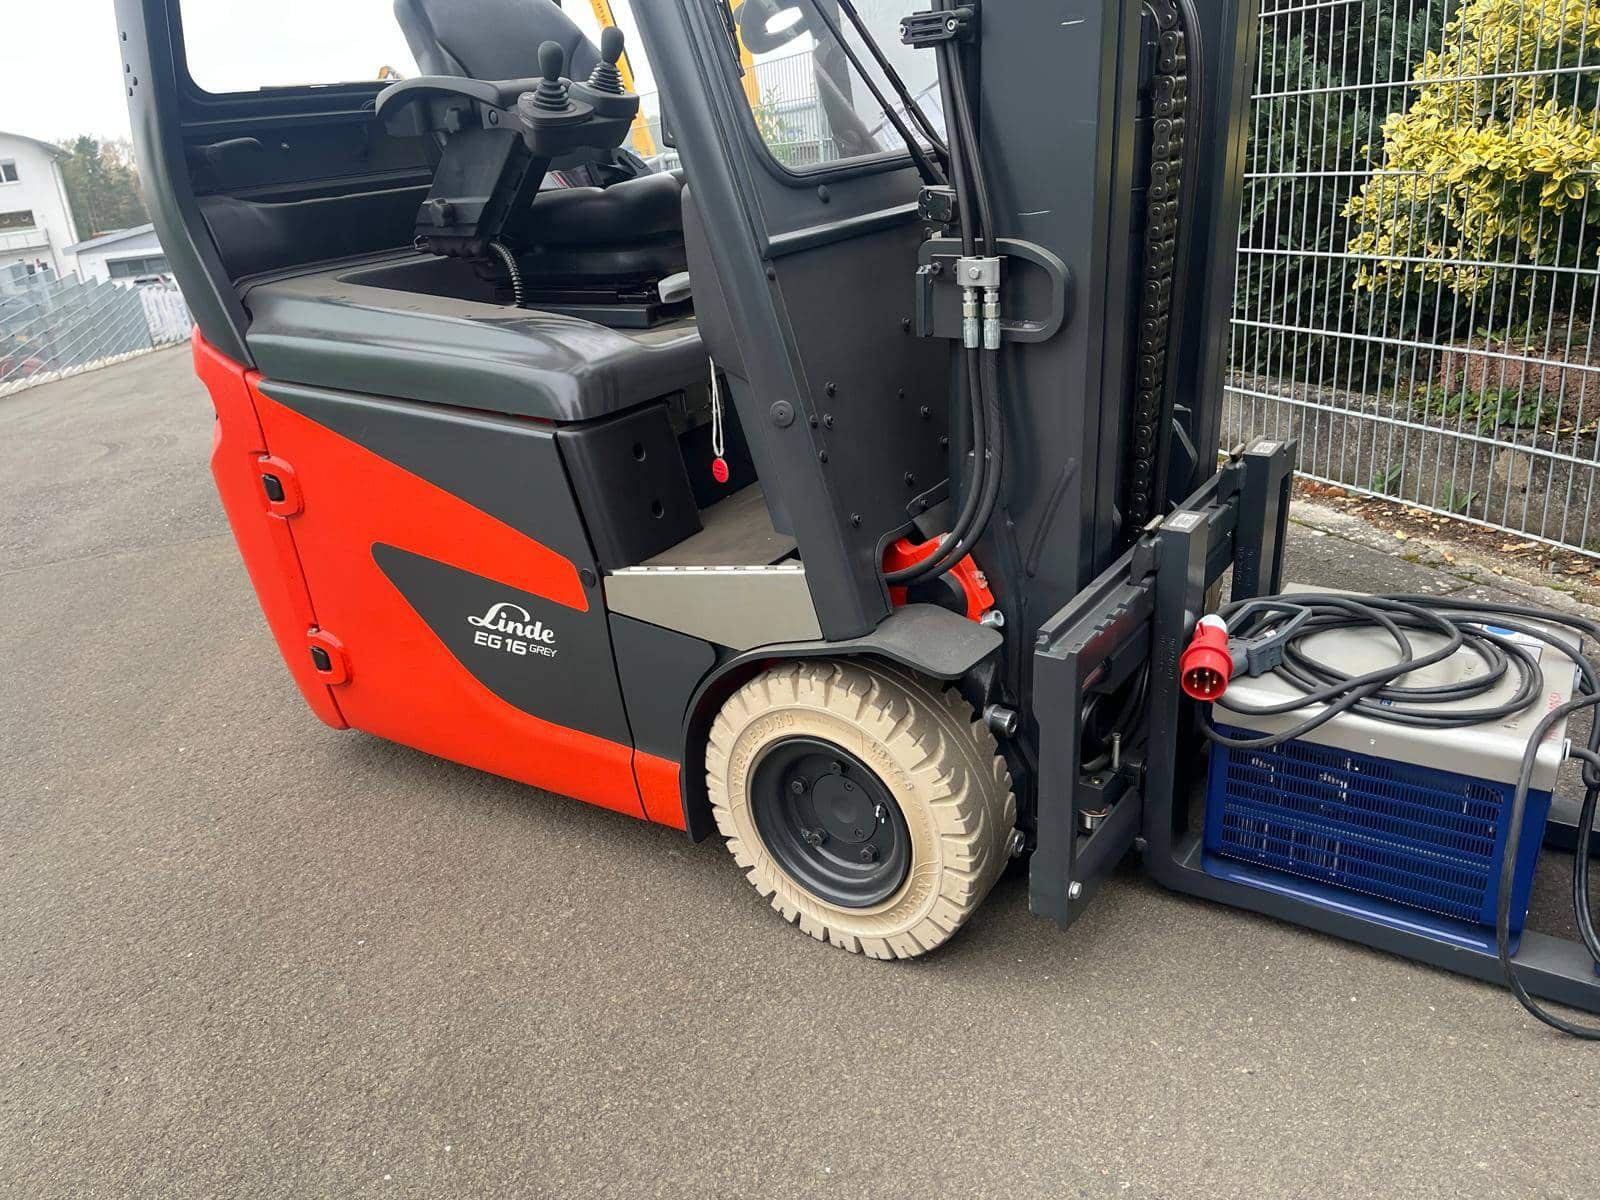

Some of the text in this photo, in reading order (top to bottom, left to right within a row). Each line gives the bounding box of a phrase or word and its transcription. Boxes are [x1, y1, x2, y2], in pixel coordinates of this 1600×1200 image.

[467, 603, 555, 643] Linde
[474, 631, 557, 657] EG 16 GREY
